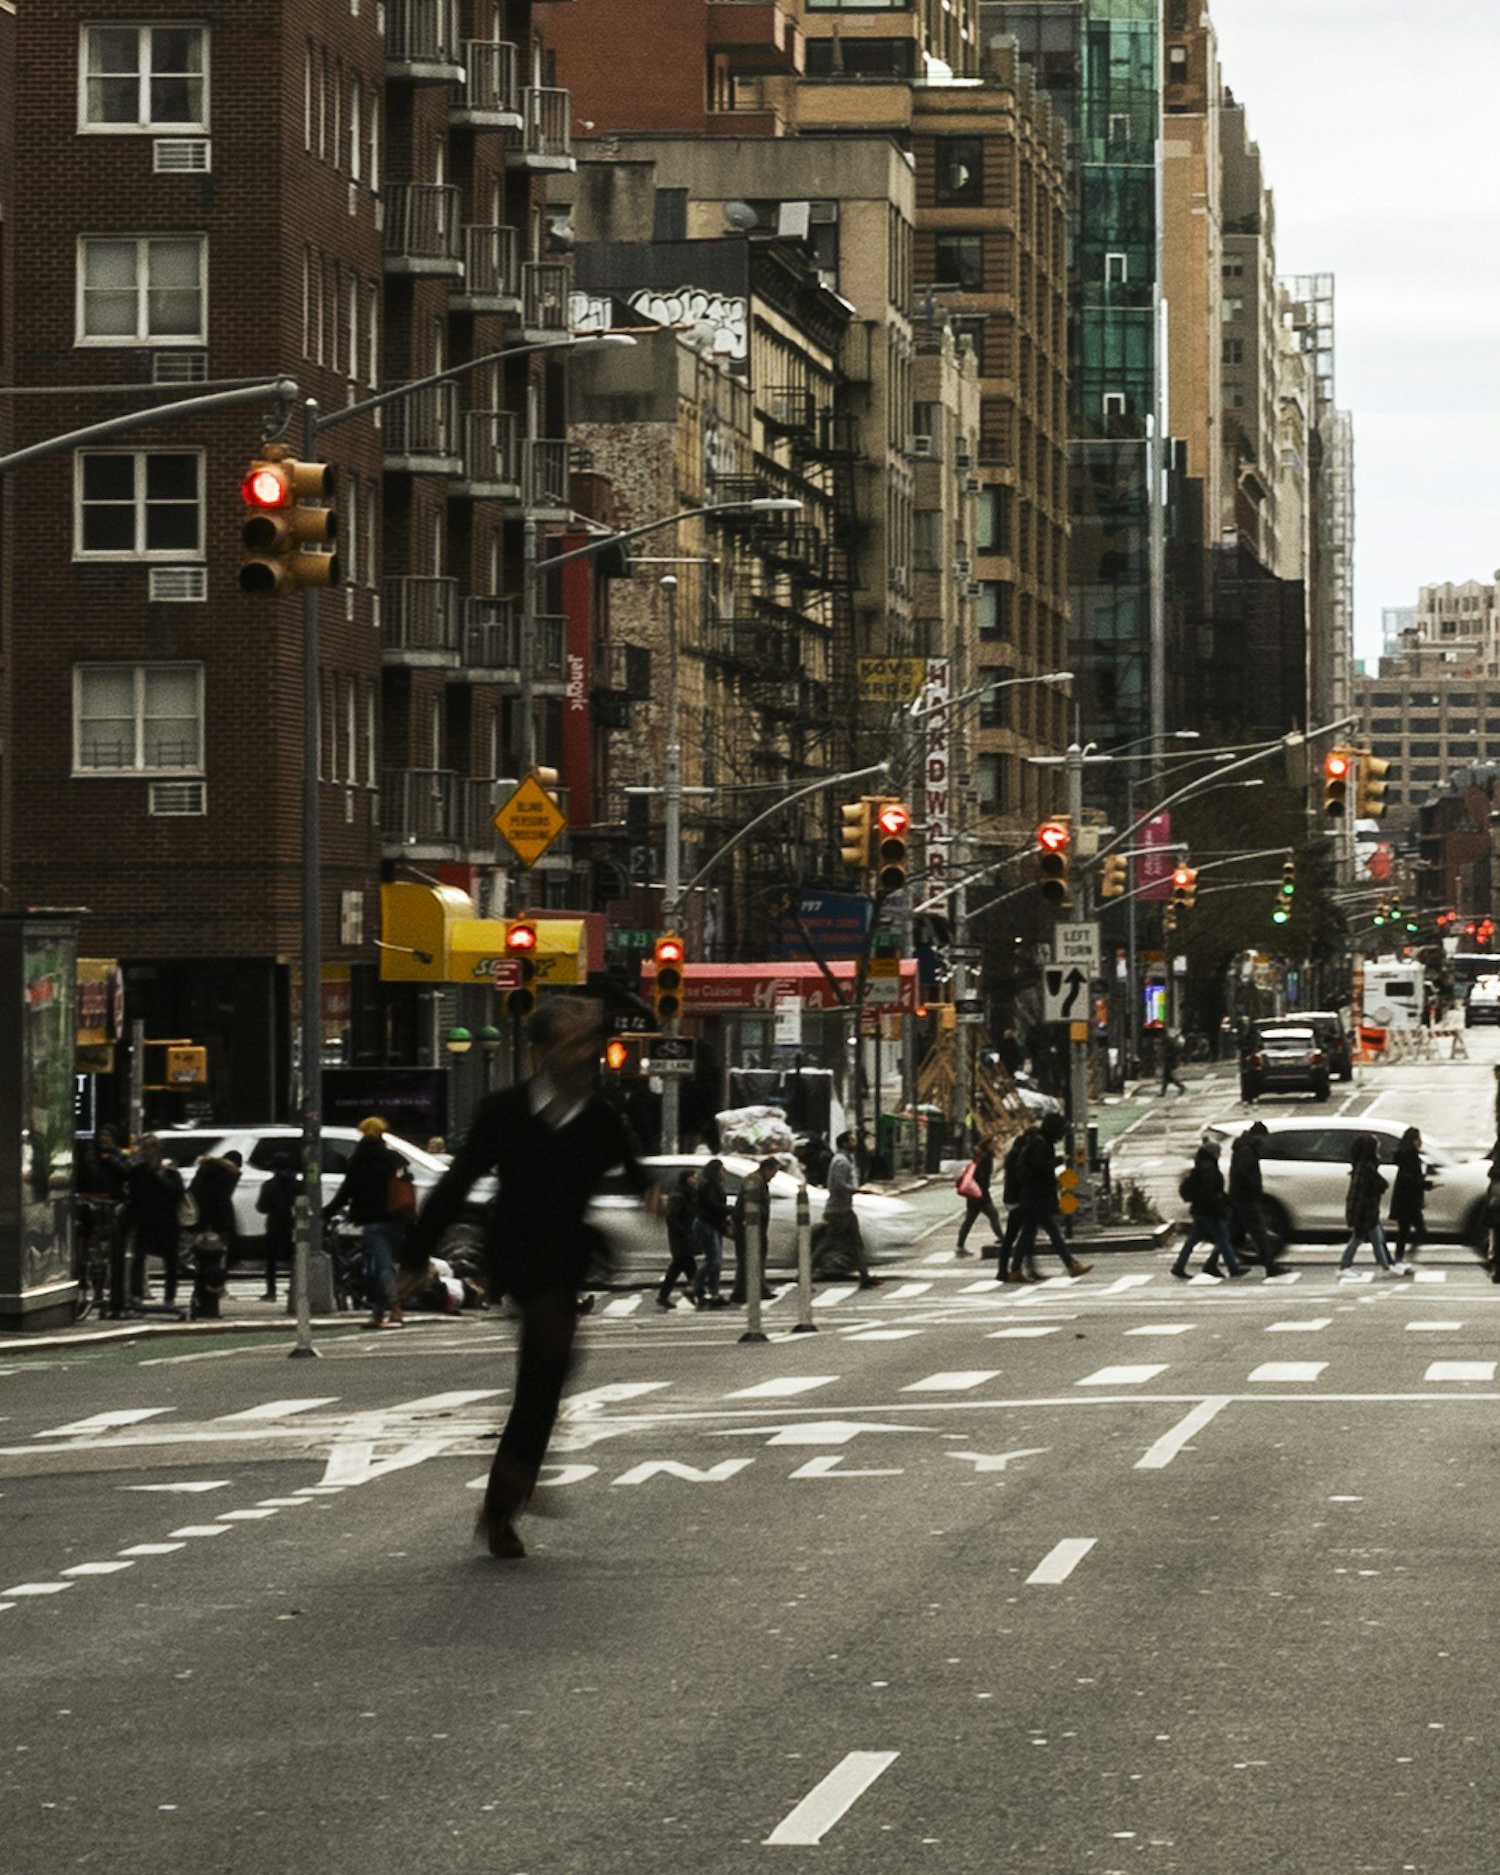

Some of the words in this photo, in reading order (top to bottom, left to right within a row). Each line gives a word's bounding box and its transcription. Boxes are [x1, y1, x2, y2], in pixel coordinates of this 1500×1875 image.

[567, 654, 587, 711] Janovic
[928, 665, 946, 909] HARDWARE
[509, 815, 549, 827] PERSONS
[1063, 930, 1090, 942] LEFT
[1063, 945, 1092, 957] TURN
[701, 985, 742, 997] Cuisine
[464, 1446, 1054, 1490] ONLY
